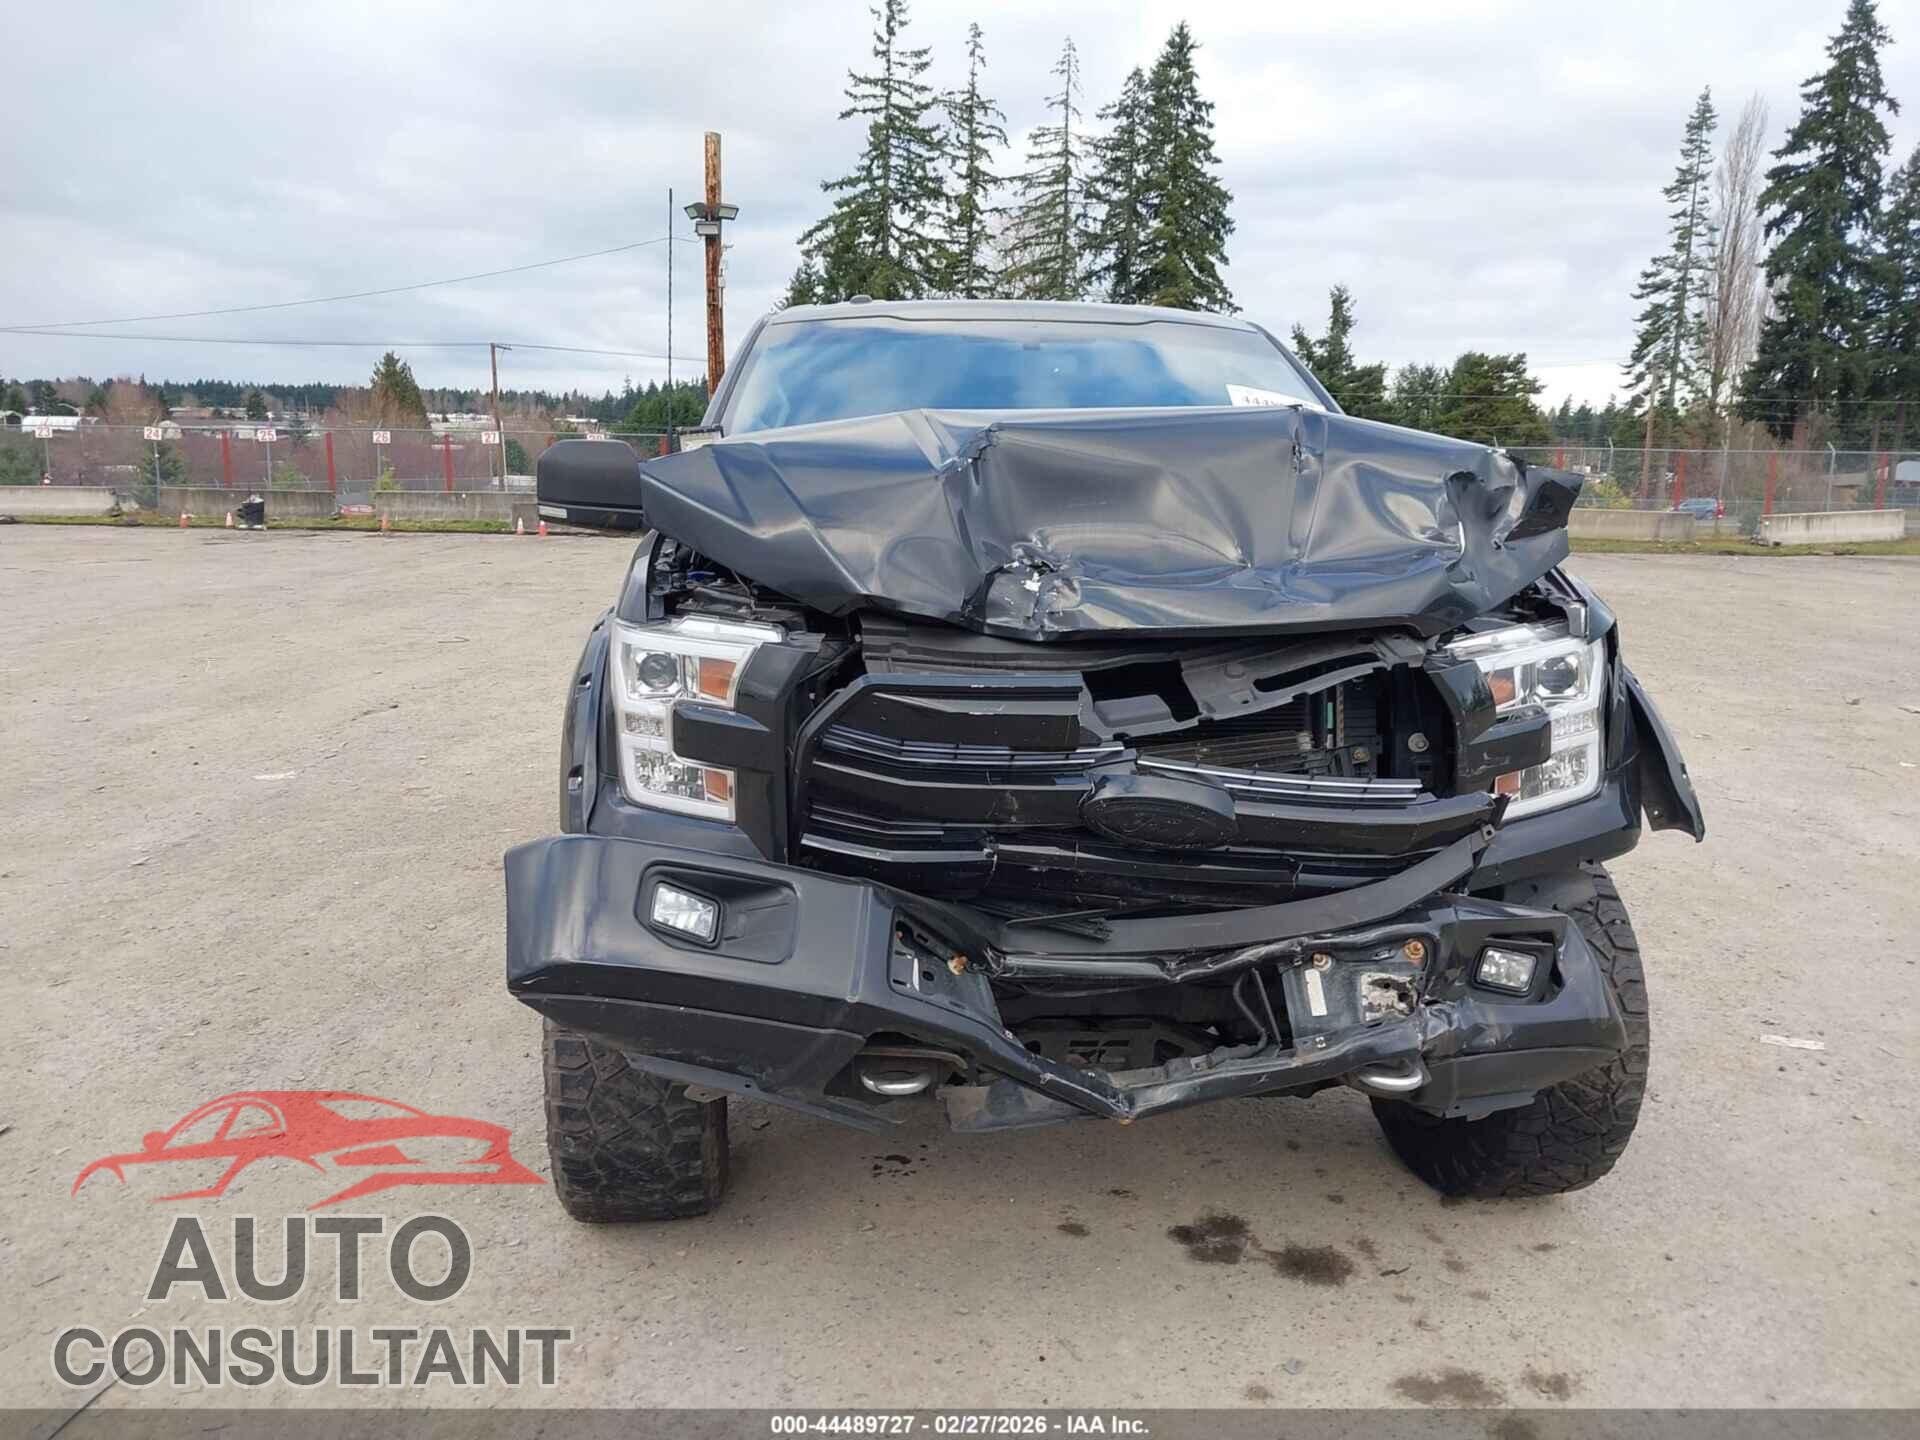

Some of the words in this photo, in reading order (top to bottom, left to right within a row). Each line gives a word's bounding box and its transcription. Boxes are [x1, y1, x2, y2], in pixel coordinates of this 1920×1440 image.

[258, 430, 275, 441] 25
[374, 431, 389, 443] 26
[483, 432, 497, 443] 27
